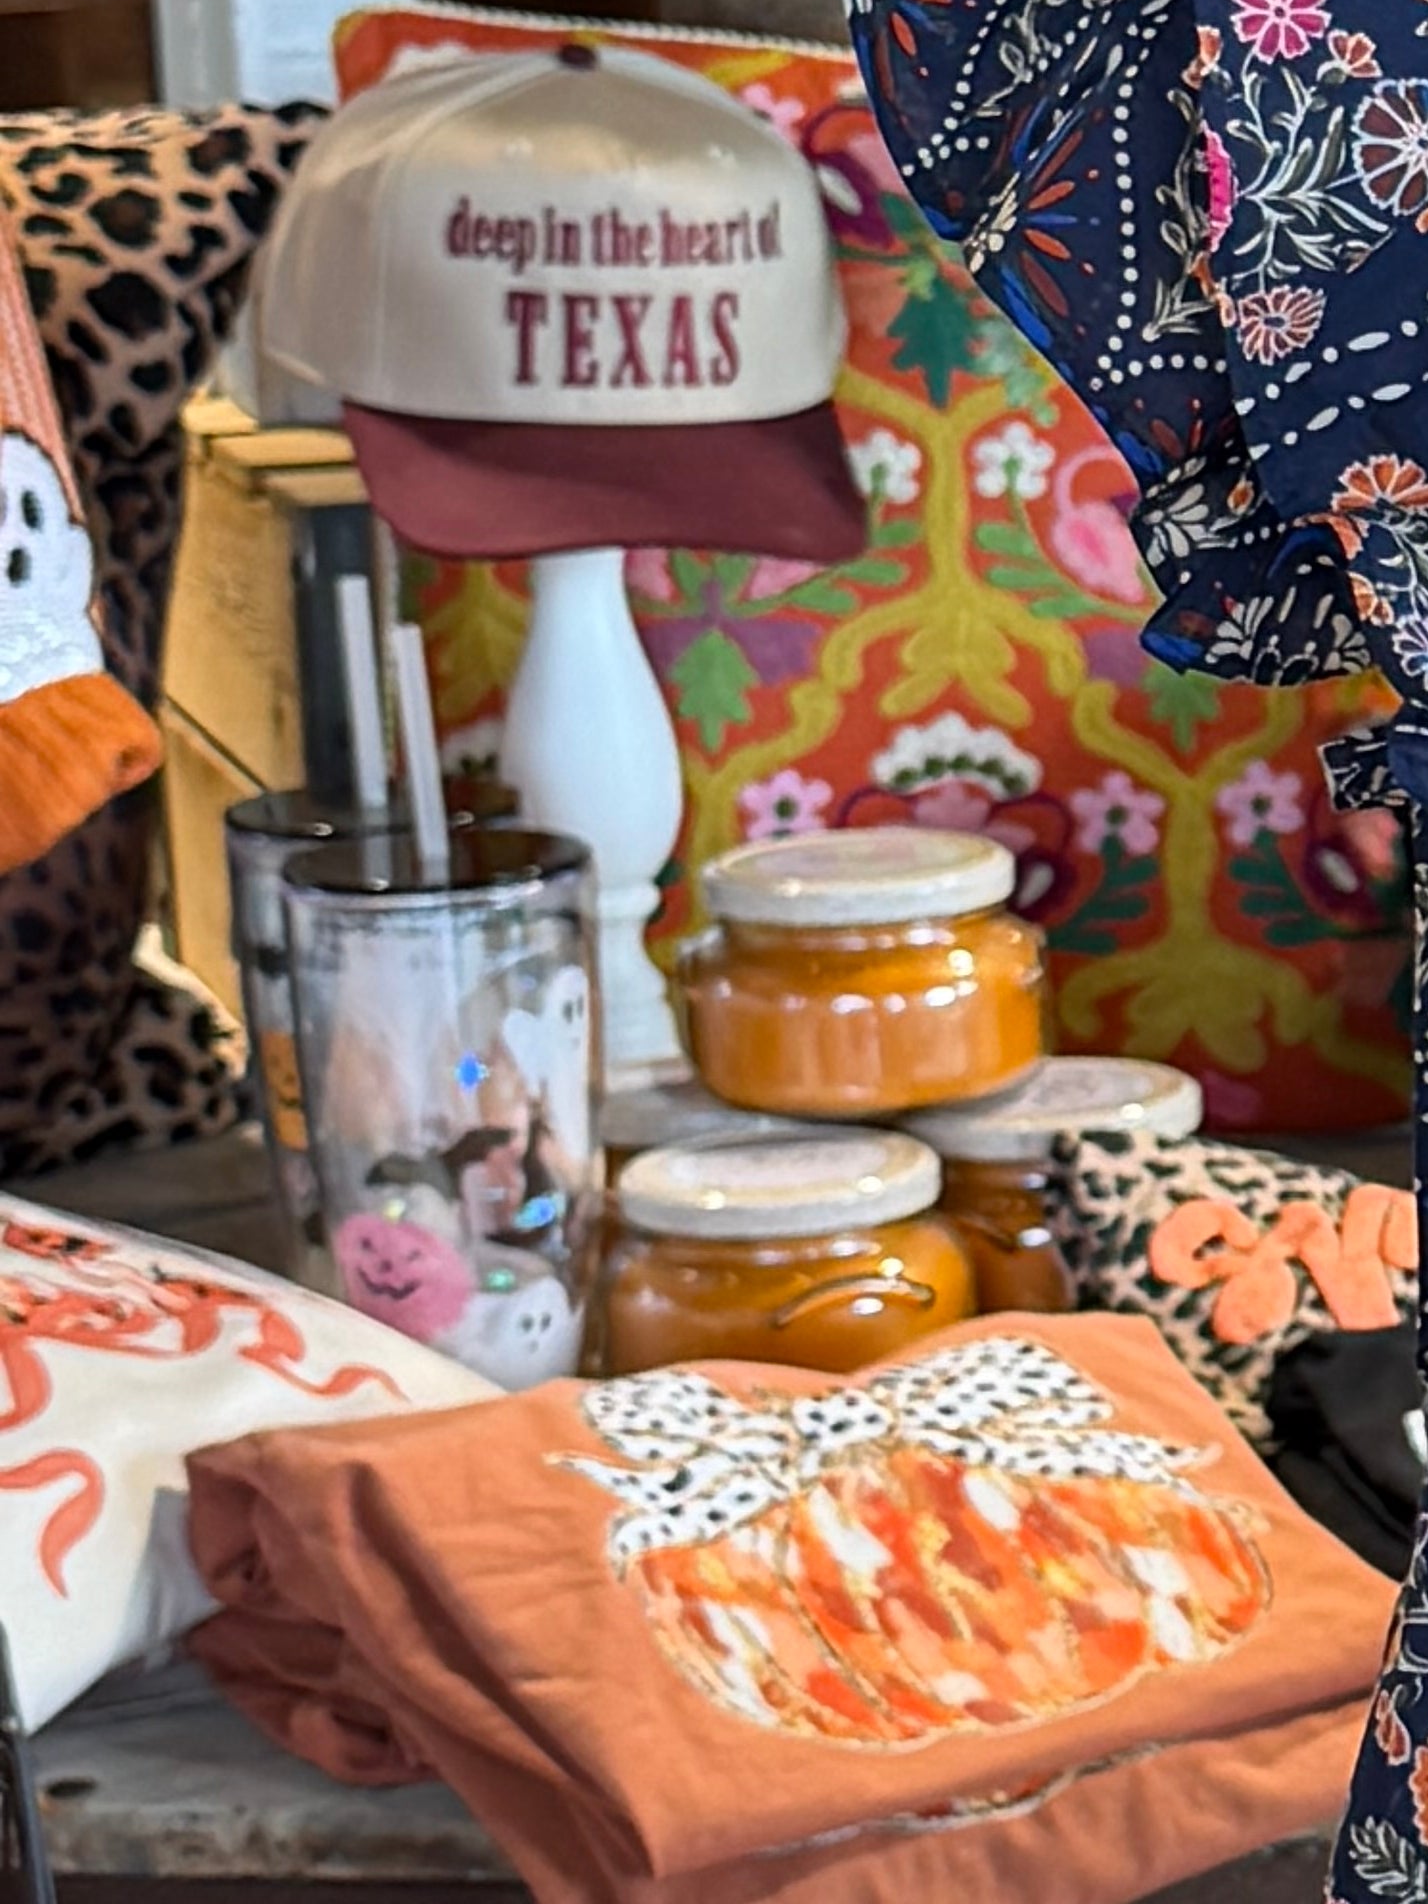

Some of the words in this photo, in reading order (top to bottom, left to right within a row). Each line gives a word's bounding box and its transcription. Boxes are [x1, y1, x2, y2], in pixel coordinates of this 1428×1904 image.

[446, 195, 538, 276] deep
[544, 206, 582, 266] in
[588, 206, 656, 268] the
[659, 208, 755, 268] heart
[503, 290, 743, 389] TEXAS
